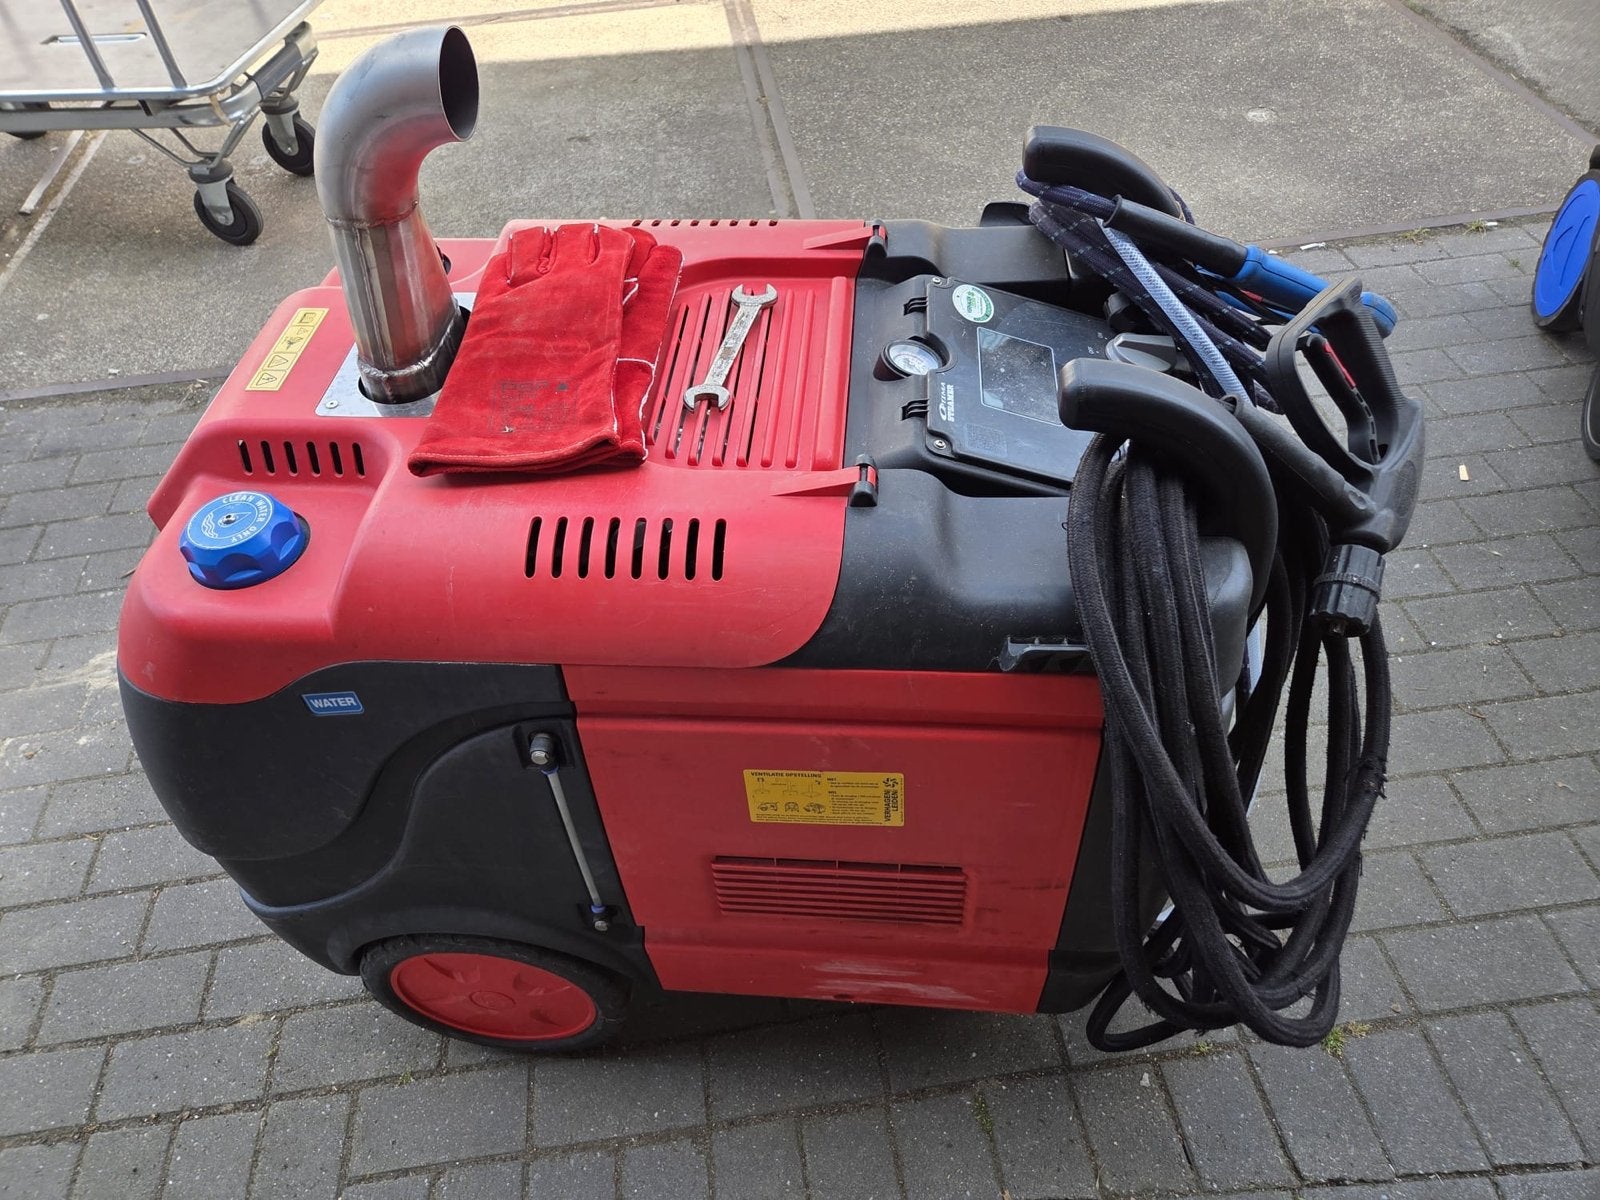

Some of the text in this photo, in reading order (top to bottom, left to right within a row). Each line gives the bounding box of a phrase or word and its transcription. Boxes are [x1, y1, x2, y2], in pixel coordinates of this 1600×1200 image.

[947, 384, 955, 423] STEAMER
[222, 494, 267, 543] CLEAN WATER ONLY
[310, 696, 357, 708] WATER
